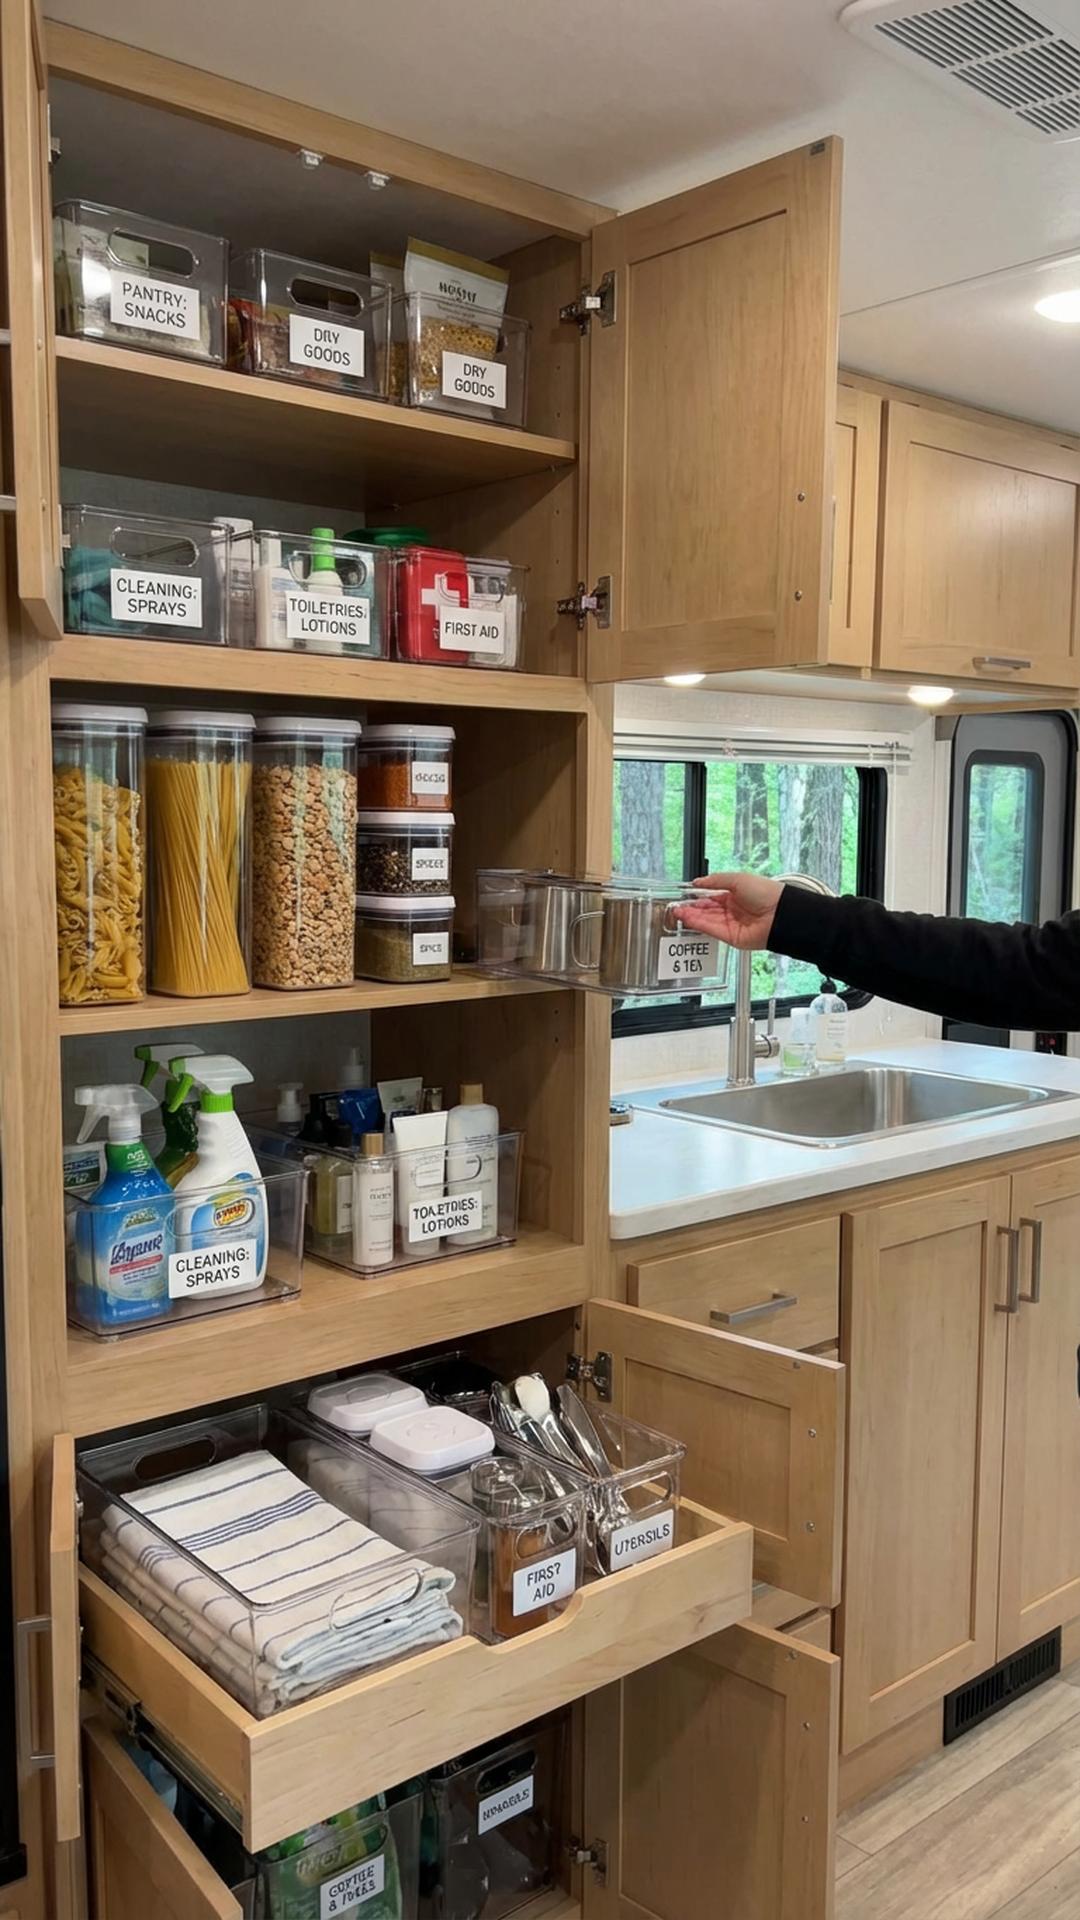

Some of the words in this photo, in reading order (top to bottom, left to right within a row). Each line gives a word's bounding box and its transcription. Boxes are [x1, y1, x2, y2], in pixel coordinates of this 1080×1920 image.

[122, 281, 187, 310] PANTRY:
[124, 302, 186, 328] SNACKS
[303, 344, 351, 366] GOODS
[463, 363, 487, 379] DRY
[454, 378, 495, 398] GOODS
[116, 577, 198, 600] CLEANING:
[128, 598, 187, 617] SPRAYS
[301, 618, 357, 636] LOTIONS
[445, 621, 477, 636] FIRST
[479, 625, 499, 639] AID
[668, 942, 710, 957] COFFEE
[176, 1247, 250, 1273] CLEANING:
[186, 1265, 240, 1288] SPRAYS
[533, 1583, 555, 1602] AID
